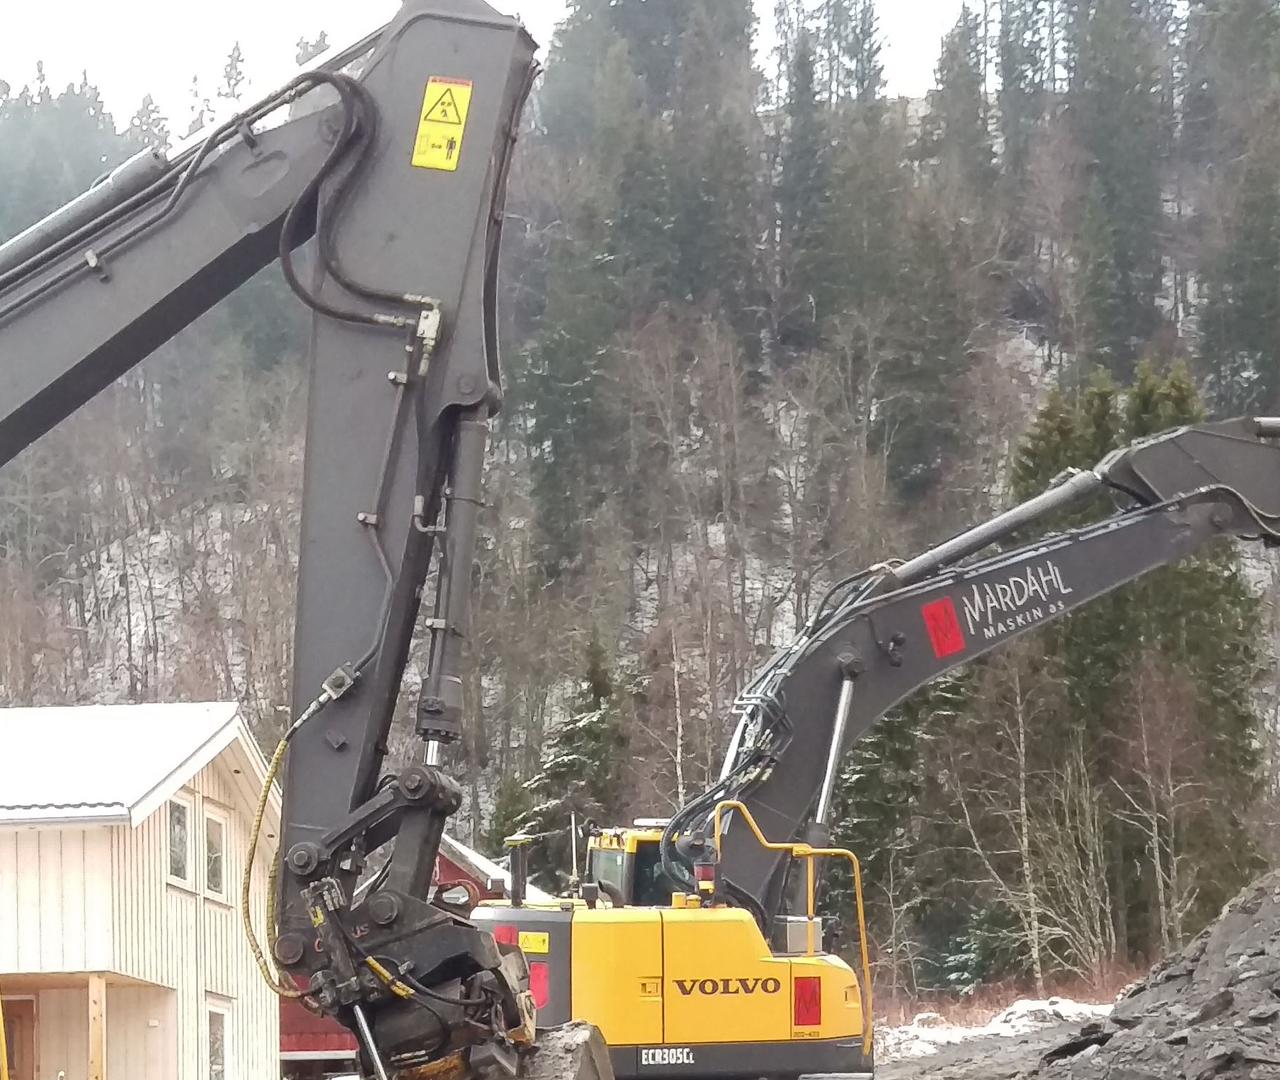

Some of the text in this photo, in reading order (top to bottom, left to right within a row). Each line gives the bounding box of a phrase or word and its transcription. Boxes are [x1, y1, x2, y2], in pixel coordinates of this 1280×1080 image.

[962, 560, 1073, 635] MARDAHL
[983, 607, 1043, 640] MASKIN
[672, 977, 781, 996] VOLVO
